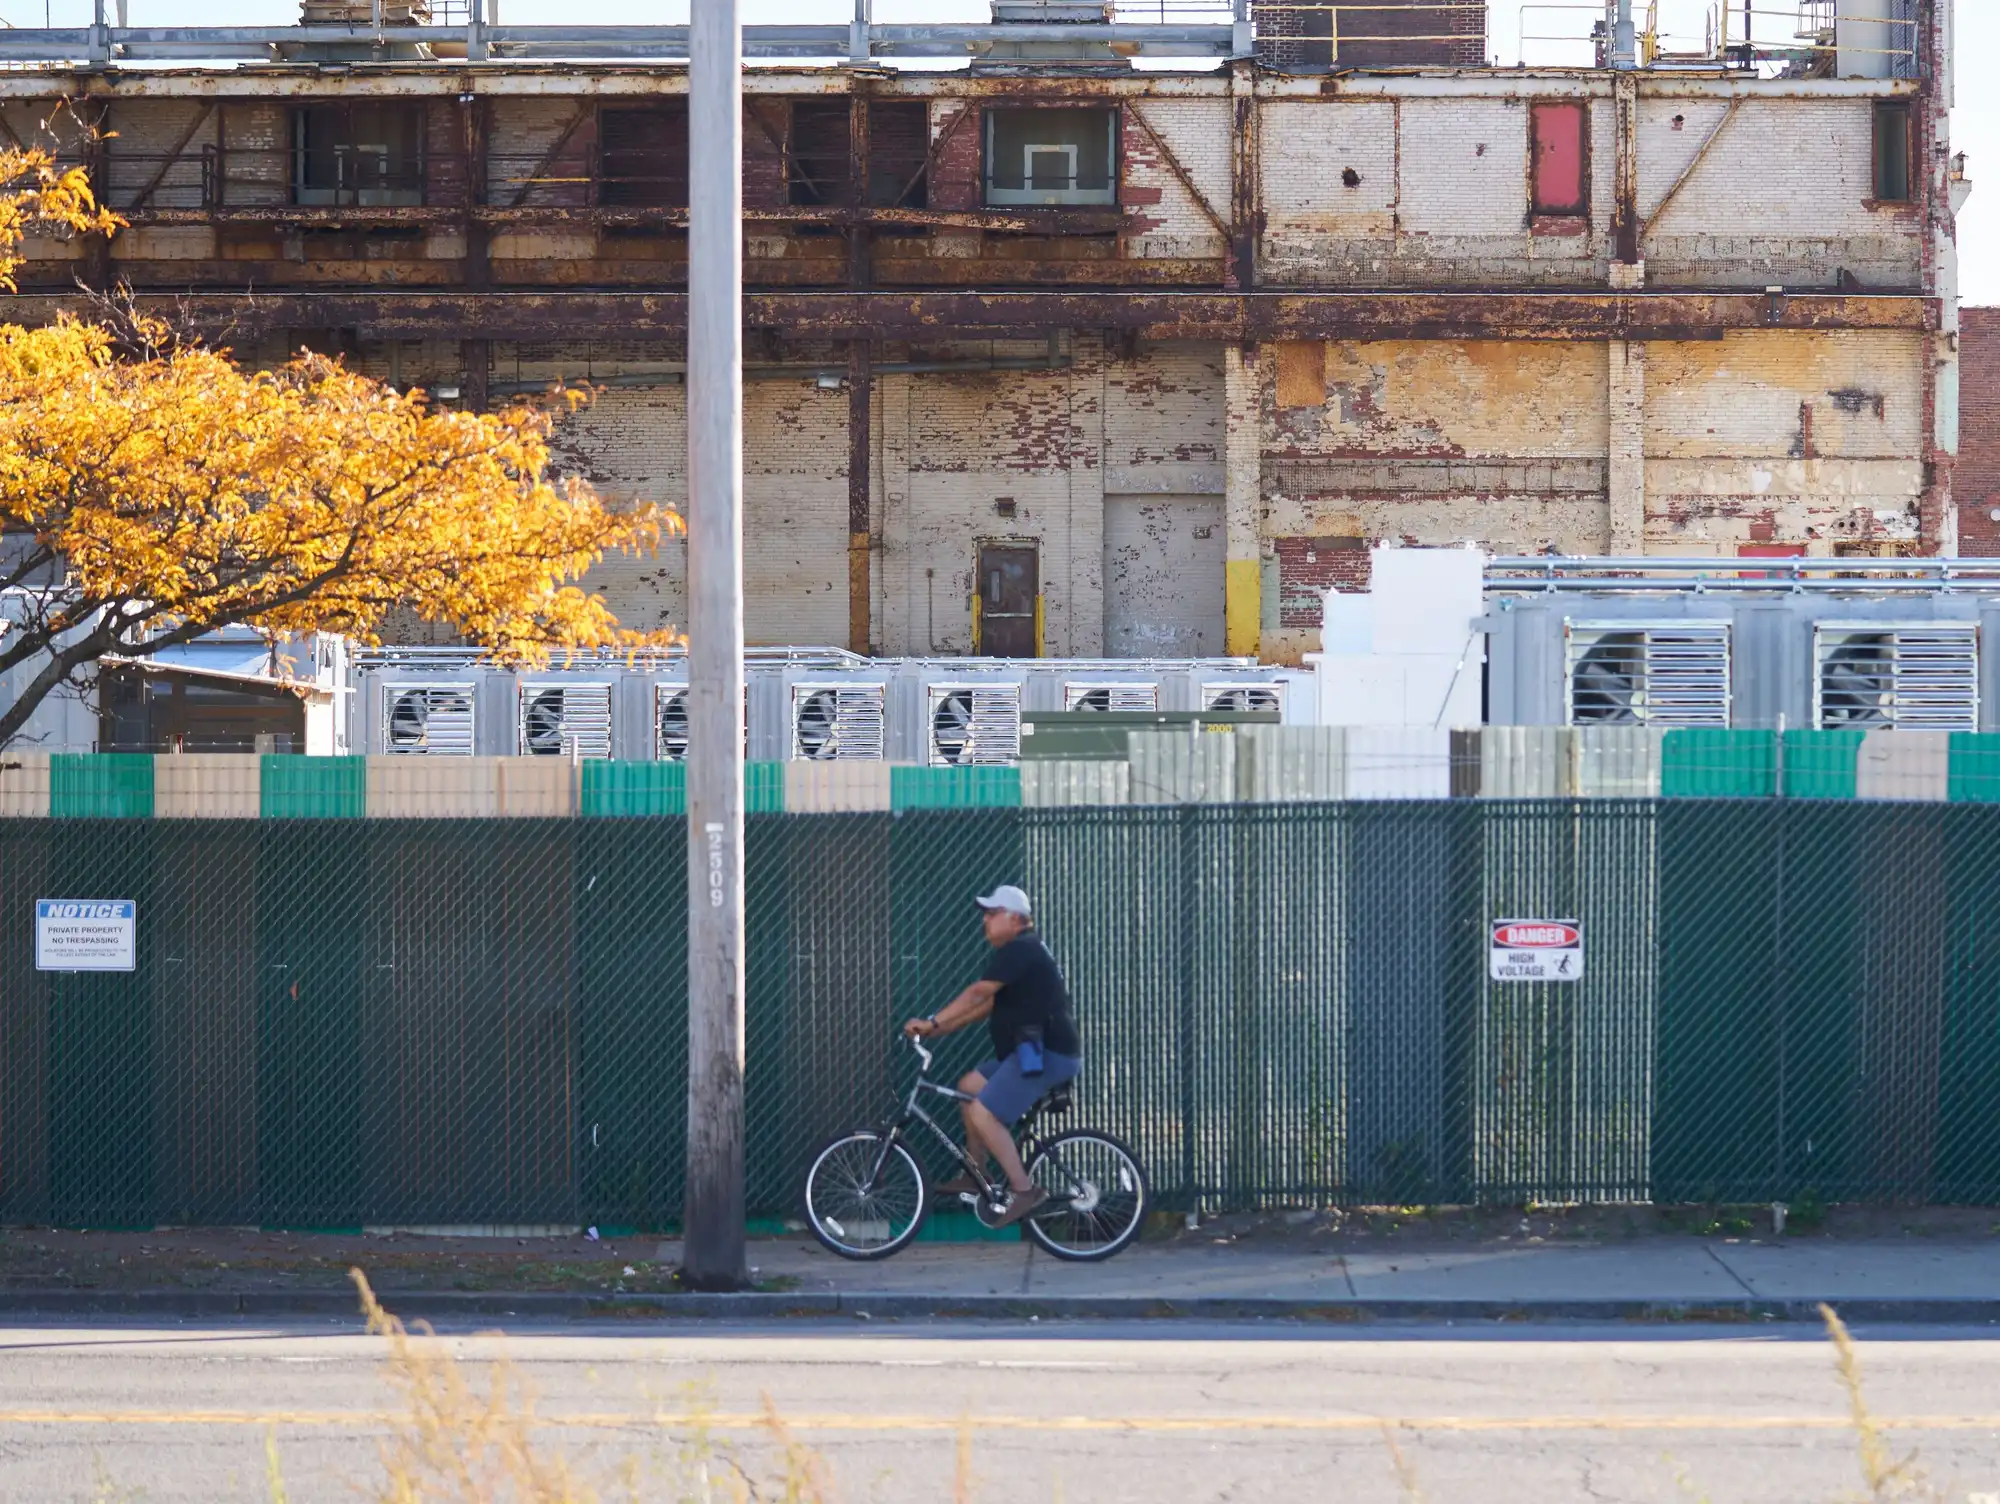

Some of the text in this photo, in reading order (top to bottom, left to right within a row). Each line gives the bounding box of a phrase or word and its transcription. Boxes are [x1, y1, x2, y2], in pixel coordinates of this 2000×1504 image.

[708, 832, 724, 908] 2509
[47, 903, 125, 918] NOTICE
[48, 926, 124, 934] PRIVATE PROPERTY
[1508, 927, 1565, 943] DANGER
[65, 937, 119, 945] TRESPASSING
[1508, 952, 1536, 963] HIGH
[1497, 965, 1545, 976] VOLTAGE
